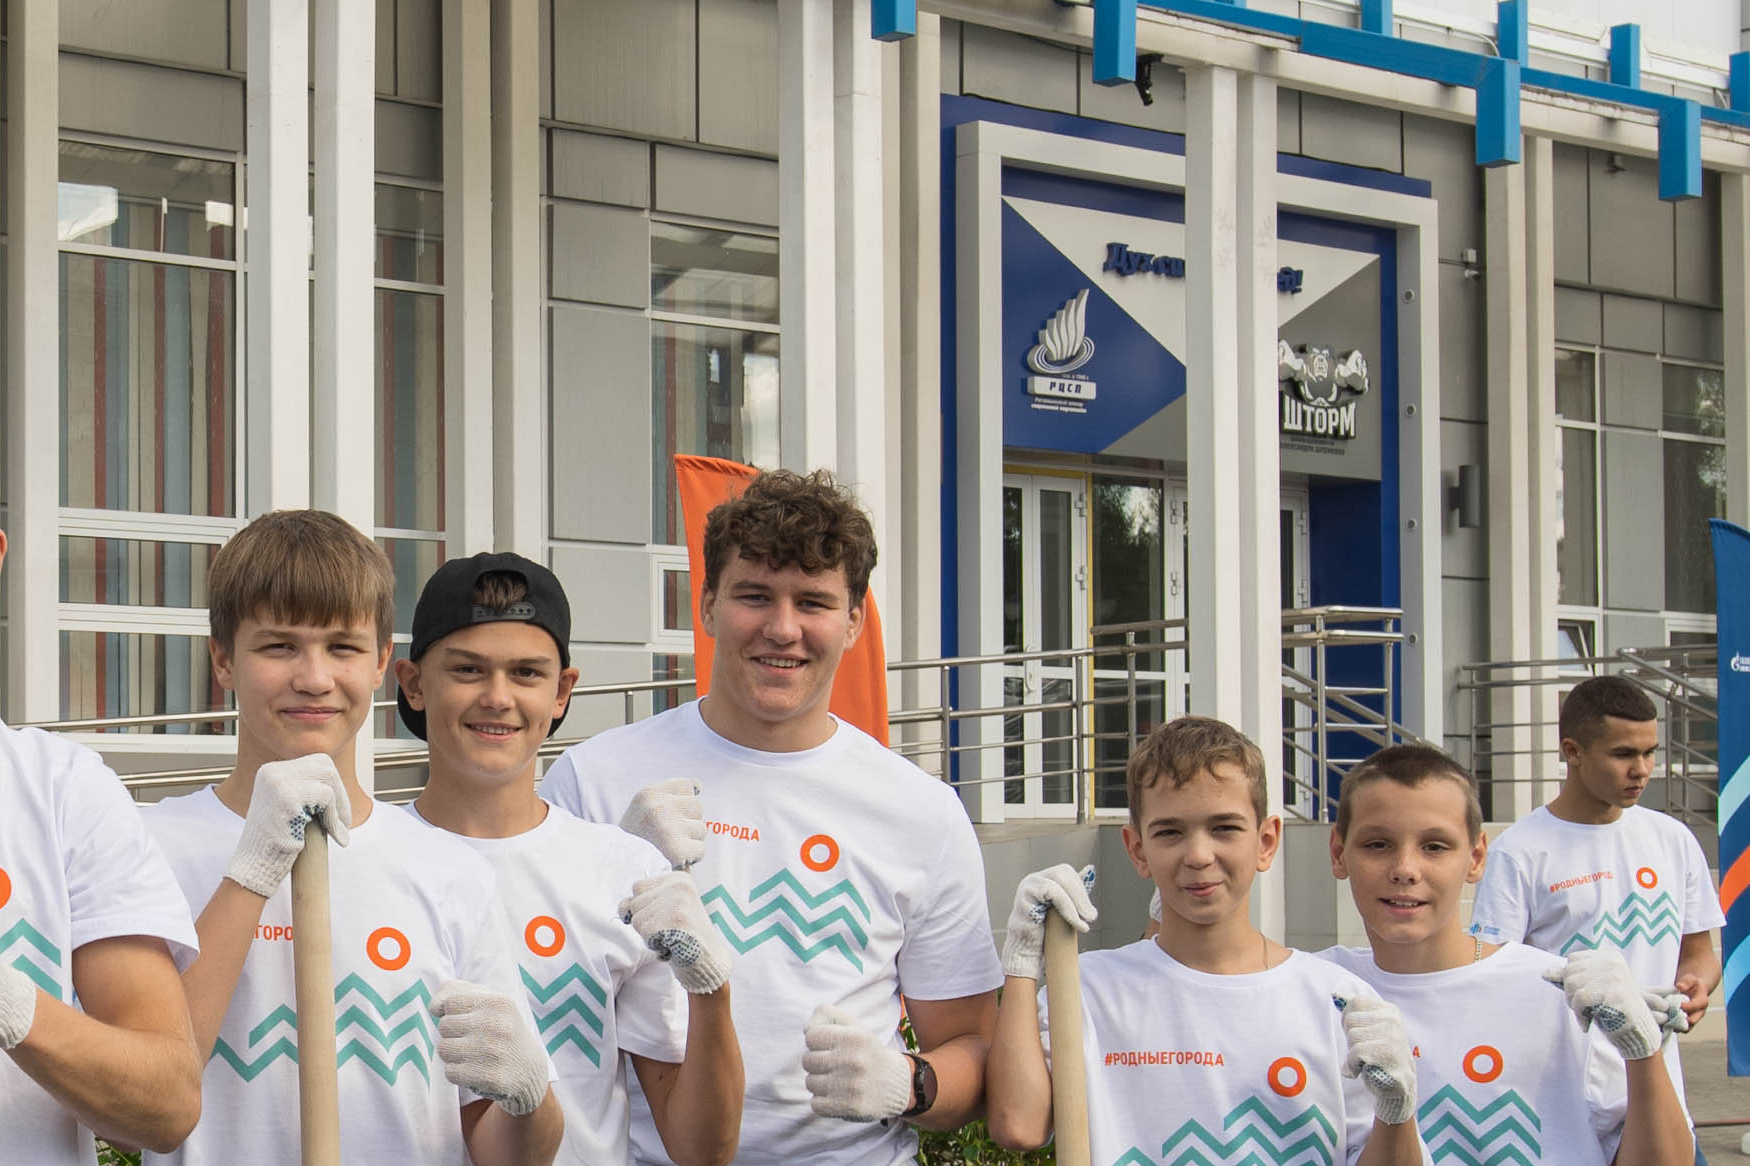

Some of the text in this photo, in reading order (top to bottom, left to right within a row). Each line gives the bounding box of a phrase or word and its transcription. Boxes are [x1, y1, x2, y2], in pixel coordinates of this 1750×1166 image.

[1049, 381, 1082, 394] РЦСП
[1283, 394, 1356, 437] ШТОРМ
[1104, 1051, 1225, 1066] #РОДНЫЕГОРОДА
